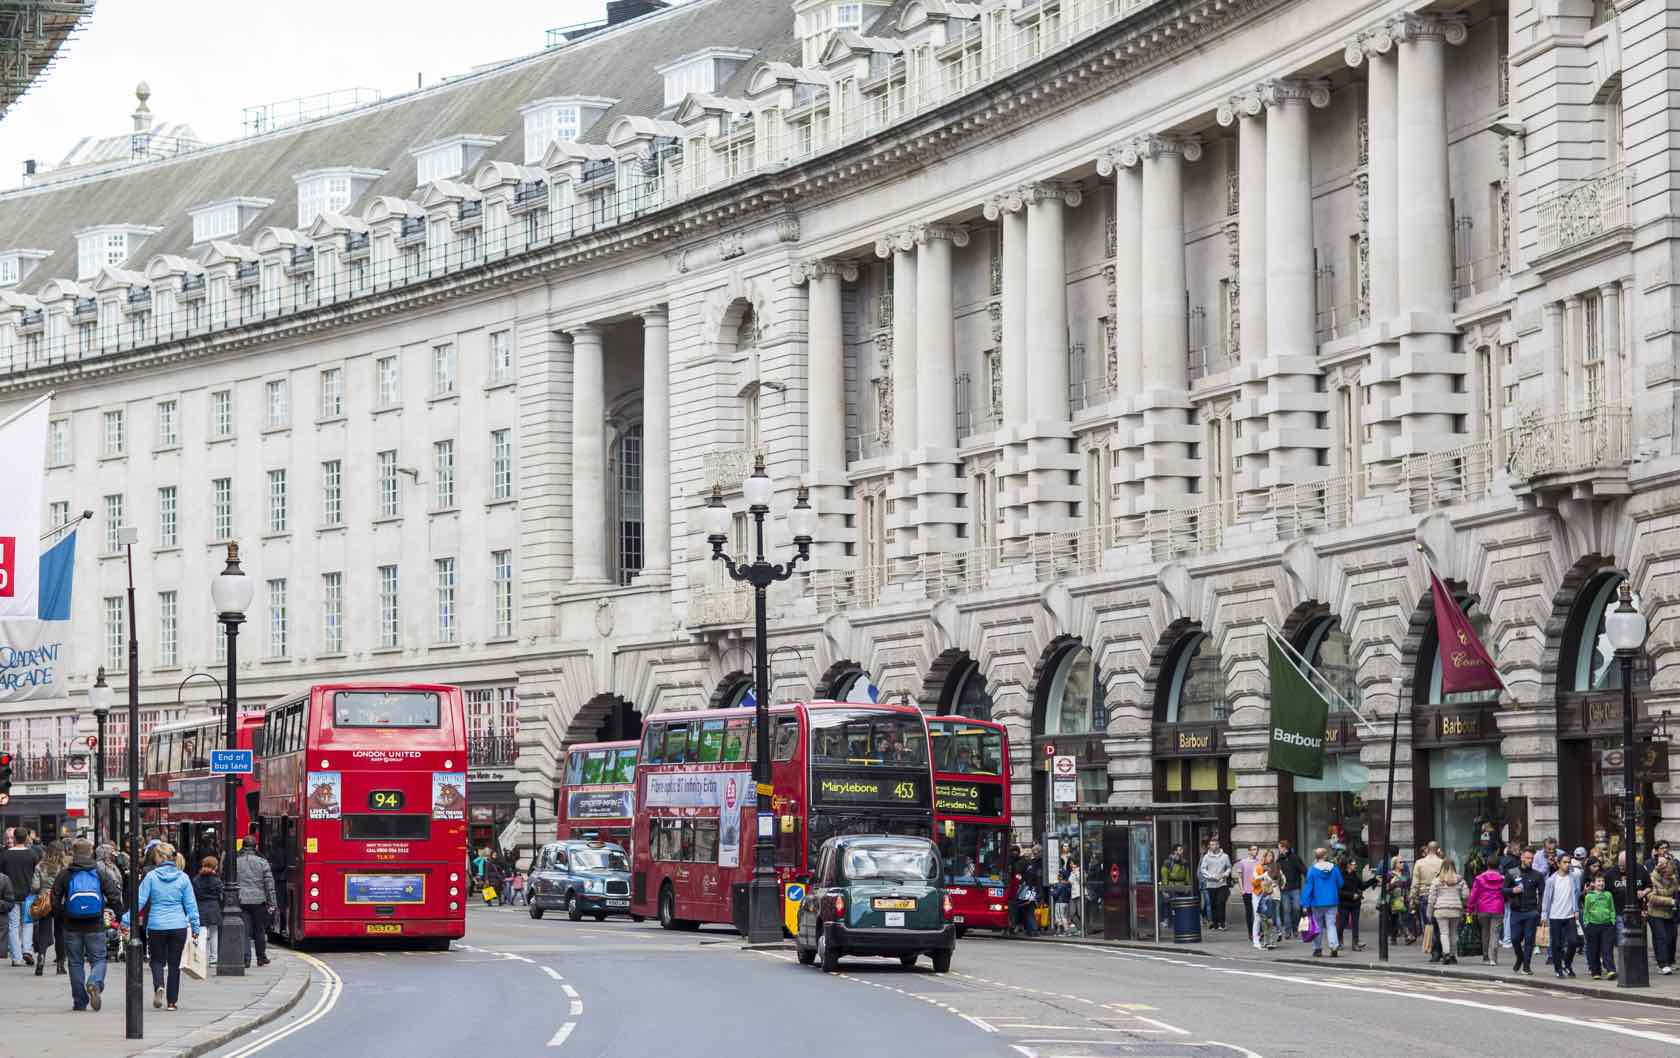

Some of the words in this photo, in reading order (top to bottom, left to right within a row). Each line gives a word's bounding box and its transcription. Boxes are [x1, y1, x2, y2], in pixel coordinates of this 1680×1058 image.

[0, 667, 53, 691] ARCADE
[1442, 715, 1480, 735] Barbour
[1179, 732, 1209, 748] Barbour
[1273, 728, 1323, 748] Barbour
[218, 753, 234, 761] End
[235, 753, 245, 761] of
[1047, 745, 1055, 754] D
[822, 782, 878, 794] Marylebone
[894, 782, 914, 798] 453
[970, 787, 978, 798] 6
[375, 793, 398, 807] 94
